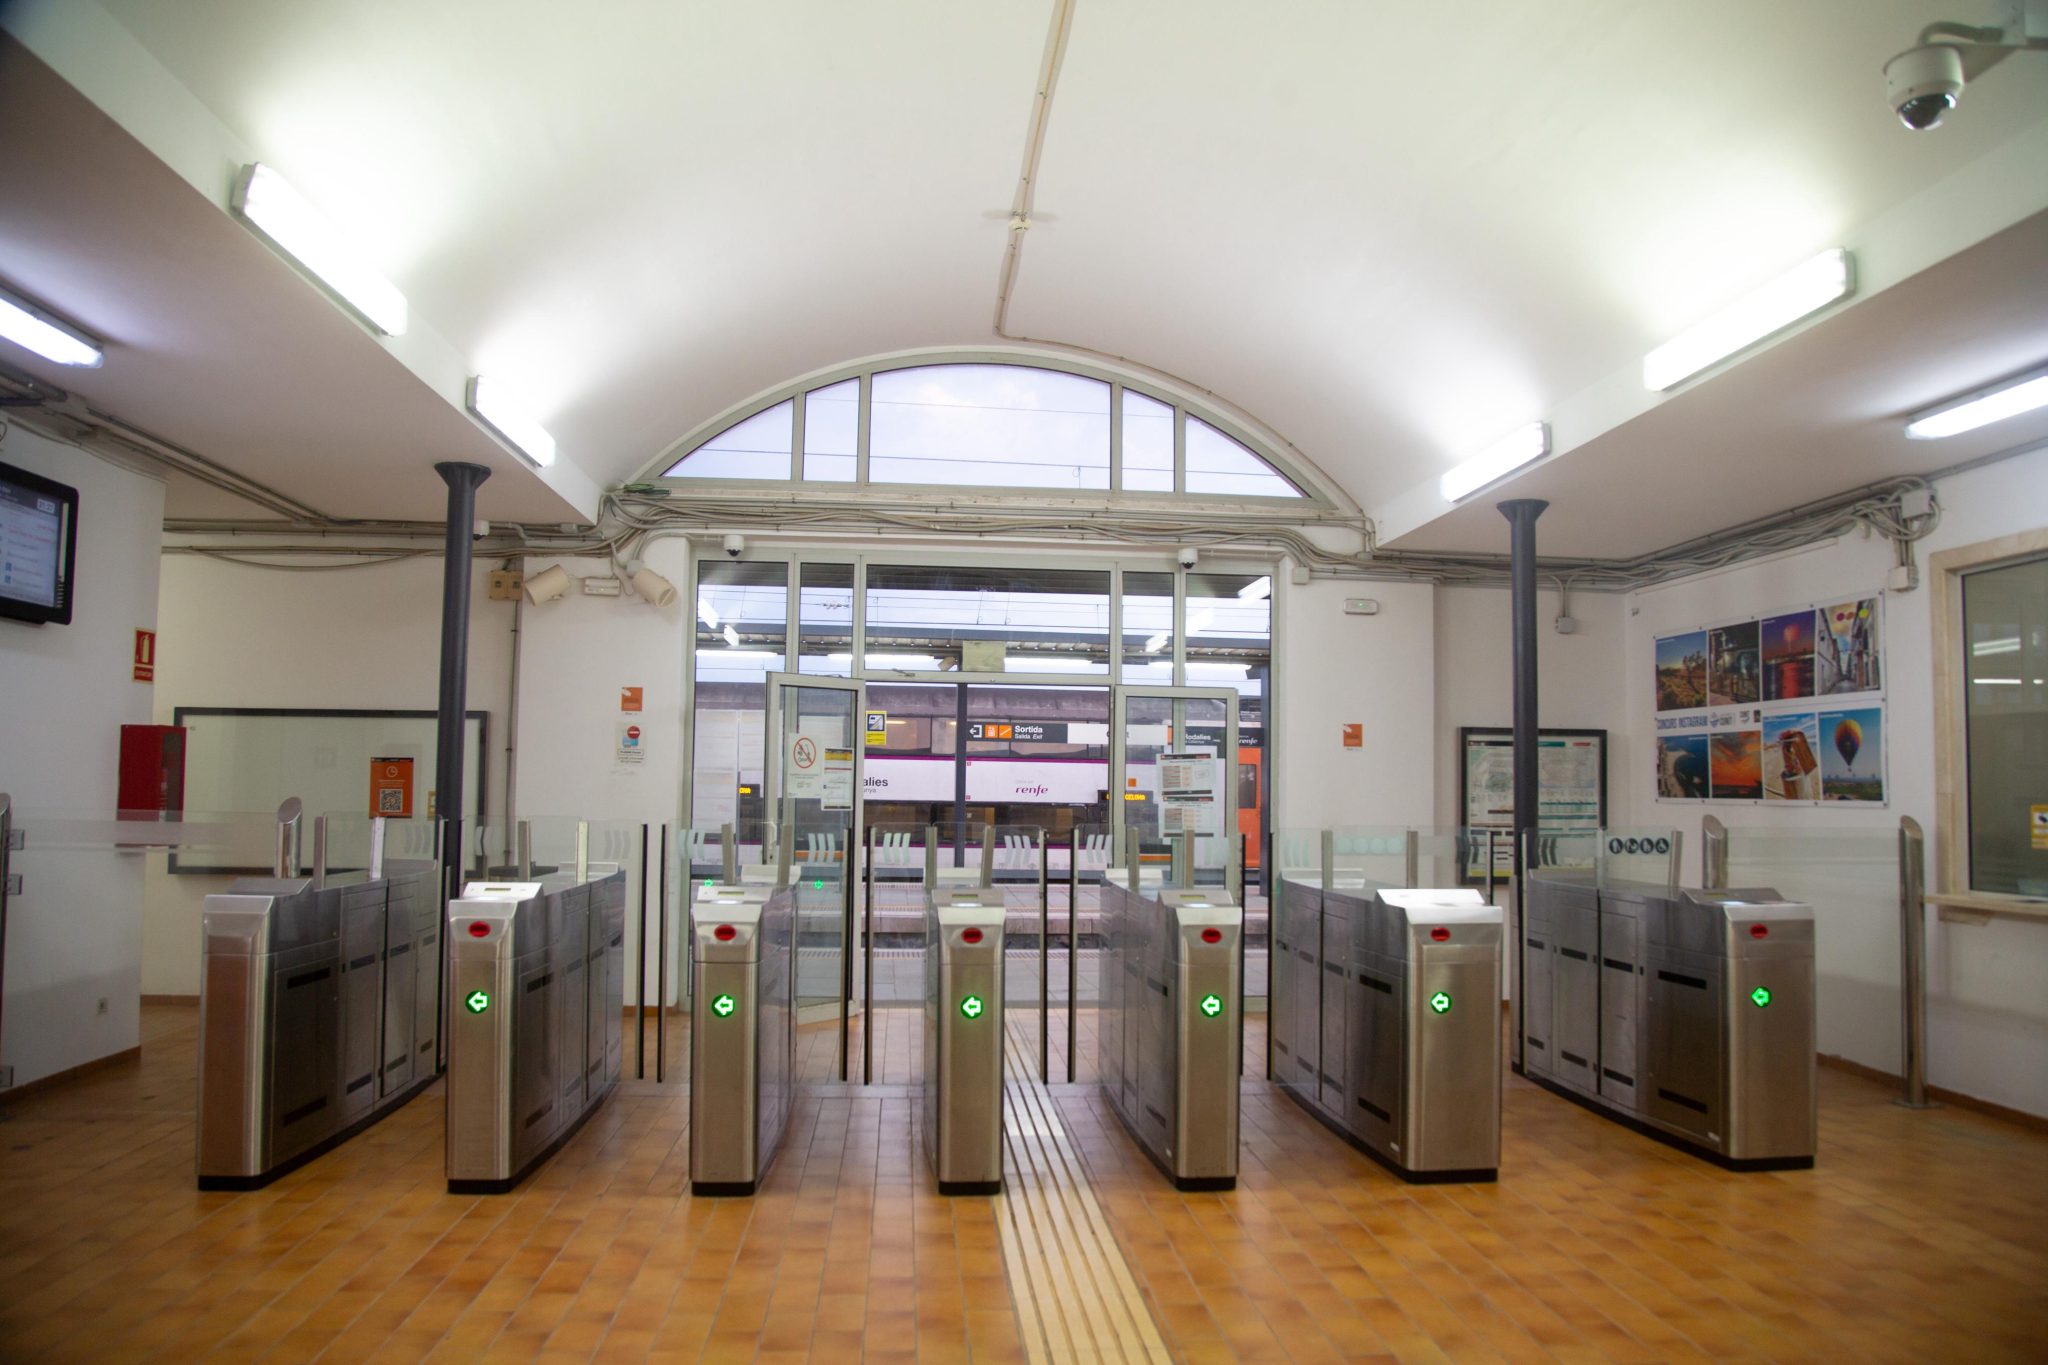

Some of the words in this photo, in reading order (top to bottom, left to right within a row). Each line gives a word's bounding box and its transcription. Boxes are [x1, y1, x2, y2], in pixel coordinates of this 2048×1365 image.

[1014, 725, 1043, 733] Sortida
[1238, 737, 1258, 745] renfe
[1016, 784, 1049, 797] renfe
